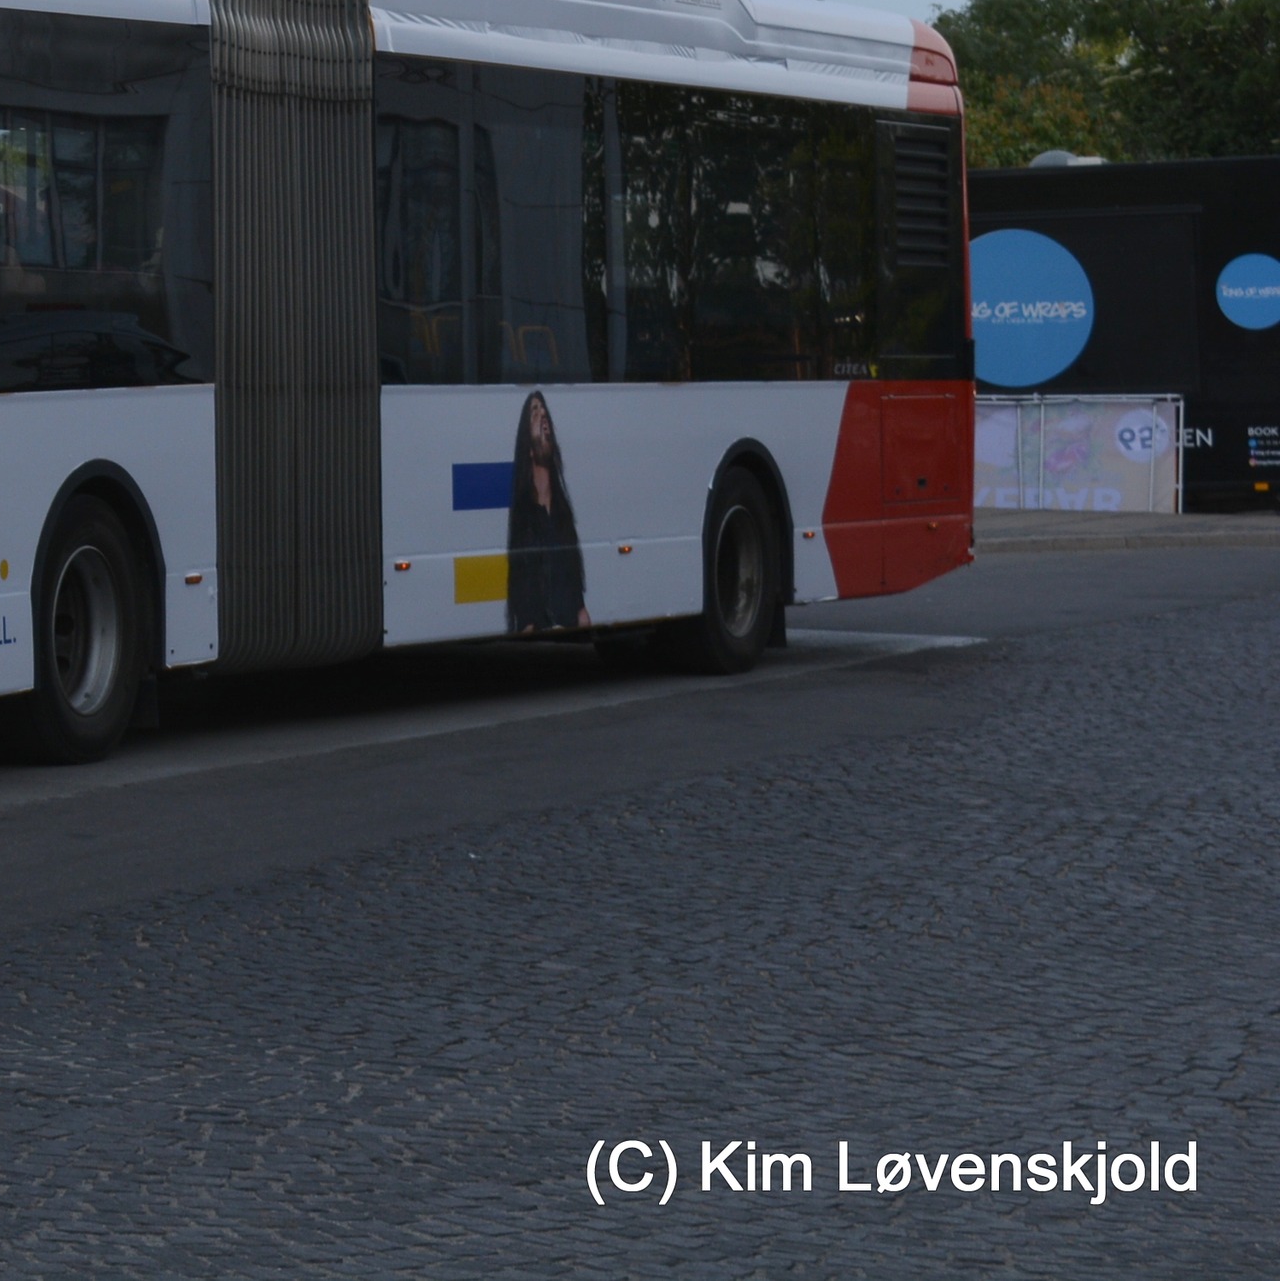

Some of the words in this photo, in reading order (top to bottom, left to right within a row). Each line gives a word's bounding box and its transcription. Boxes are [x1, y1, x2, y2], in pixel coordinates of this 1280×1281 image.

[994, 301, 1019, 318] OF
[1022, 301, 1088, 319] WRAPS
[1247, 426, 1279, 436] BOOK
